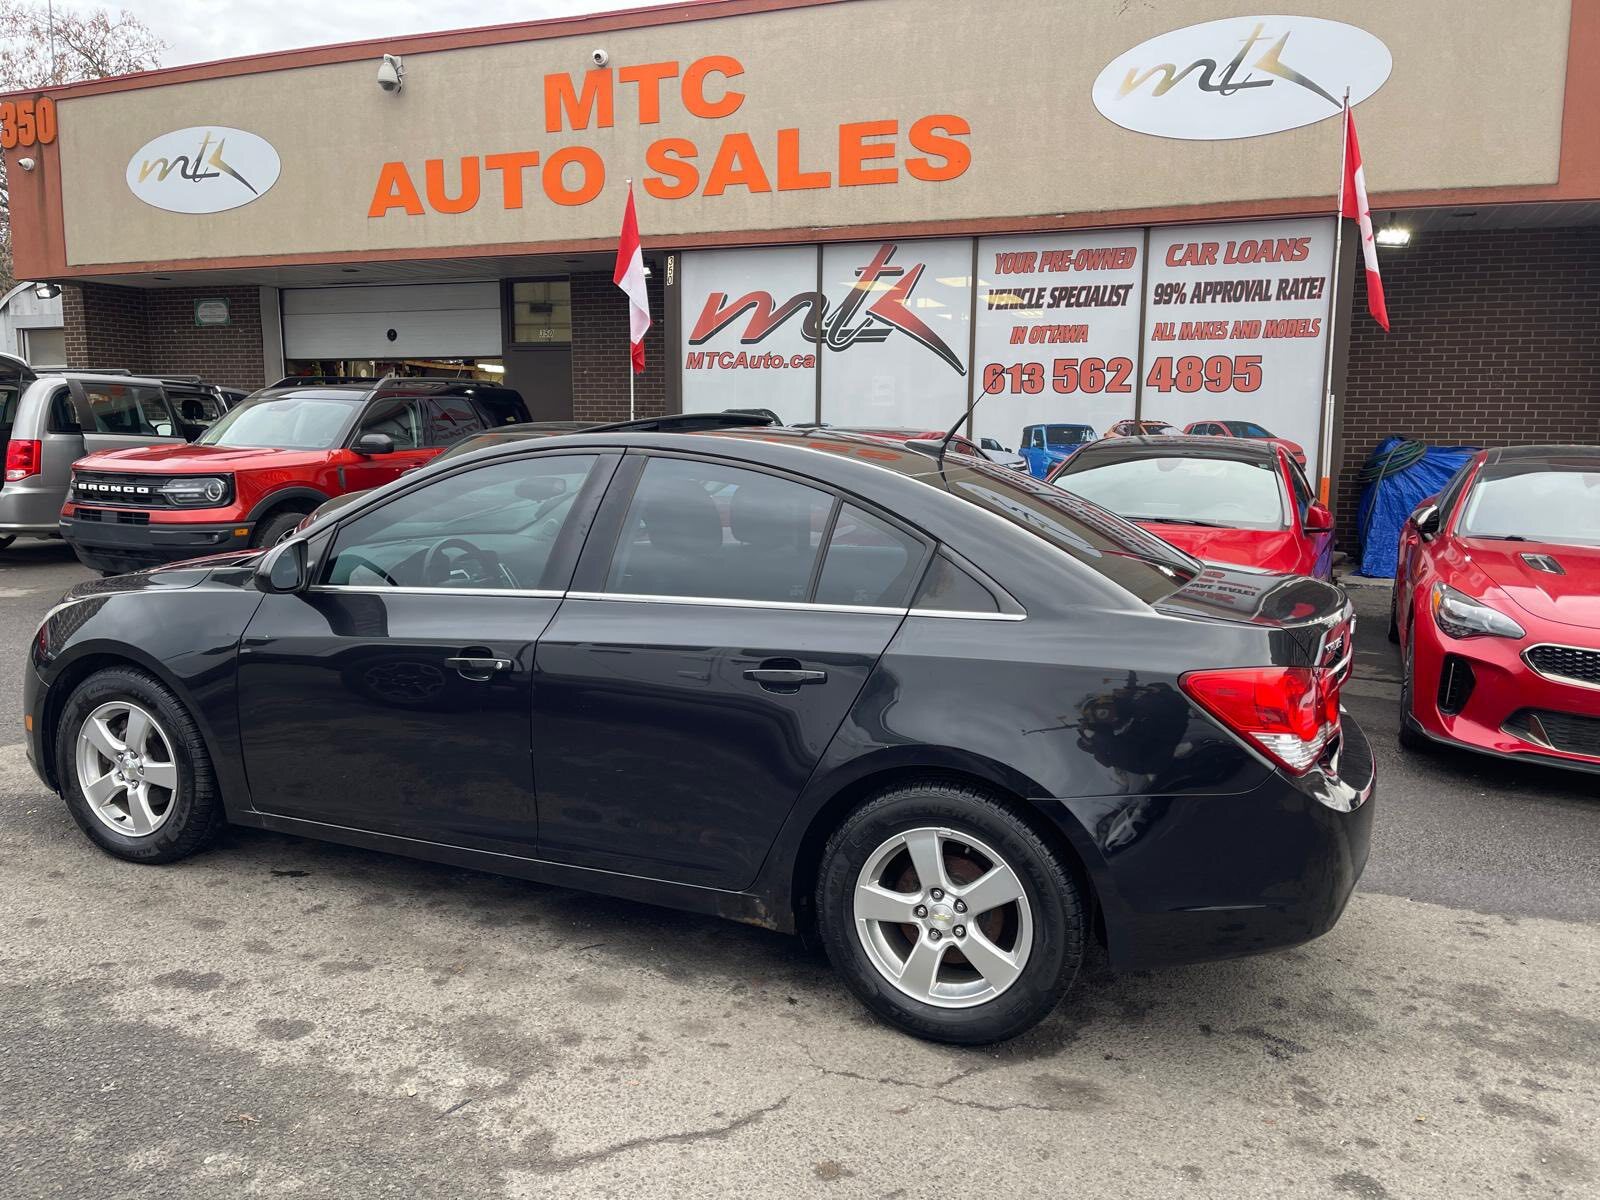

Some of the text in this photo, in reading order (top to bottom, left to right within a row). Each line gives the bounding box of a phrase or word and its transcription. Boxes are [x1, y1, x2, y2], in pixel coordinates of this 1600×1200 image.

[544, 55, 746, 133] MTC
[0, 96, 58, 149] 350
[367, 114, 972, 218] AUTO SALES
[995, 247, 1138, 274] YOUR PRE-OWNED
[1165, 237, 1312, 267] CAR LOANS
[988, 283, 1134, 310] VEHICLE SPECIALIST
[1153, 276, 1326, 305] 99% APPROVAL RATE!
[1010, 324, 1089, 344] IN OTTAWA
[1151, 318, 1322, 341] ALL MAKES AND MODELS
[685, 351, 816, 370] MTCAuto.ca
[983, 354, 1263, 395] 613 562 4895
[78, 483, 149, 494] BRONCO
